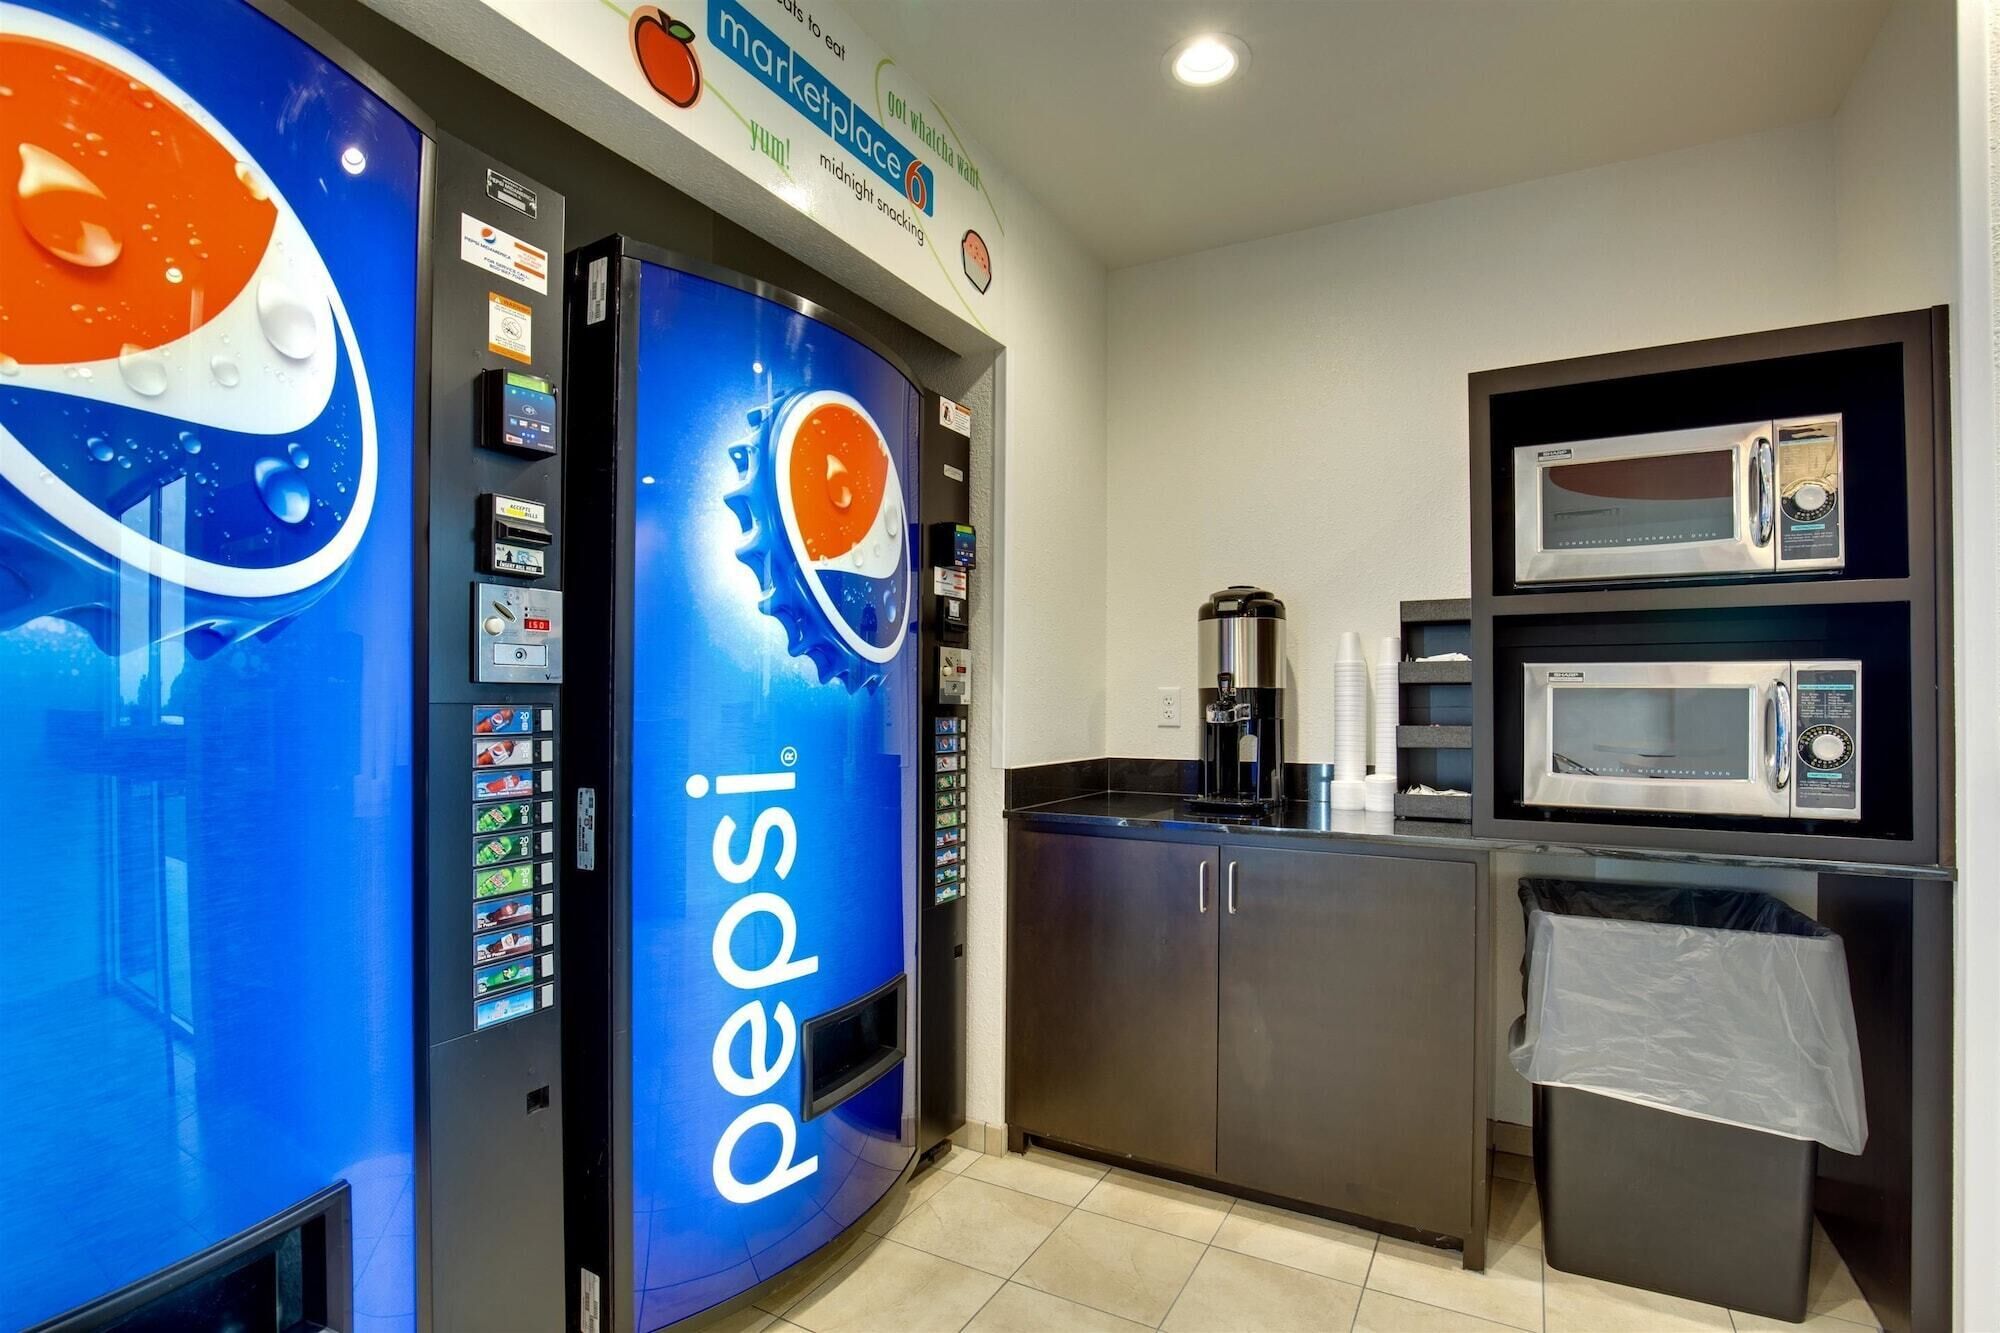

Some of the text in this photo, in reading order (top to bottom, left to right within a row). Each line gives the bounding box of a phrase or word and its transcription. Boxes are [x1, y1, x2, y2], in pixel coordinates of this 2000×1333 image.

[808, 14, 821, 38] to
[825, 35, 846, 61] eat
[720, 10, 927, 210] marketplace 6
[750, 119, 791, 169] yum!
[888, 91, 981, 191] got whatcha want
[820, 153, 925, 247] midnight snacking
[1559, 538, 1619, 546] COMMERCIAL
[1626, 534, 1683, 542] MICROWAVE
